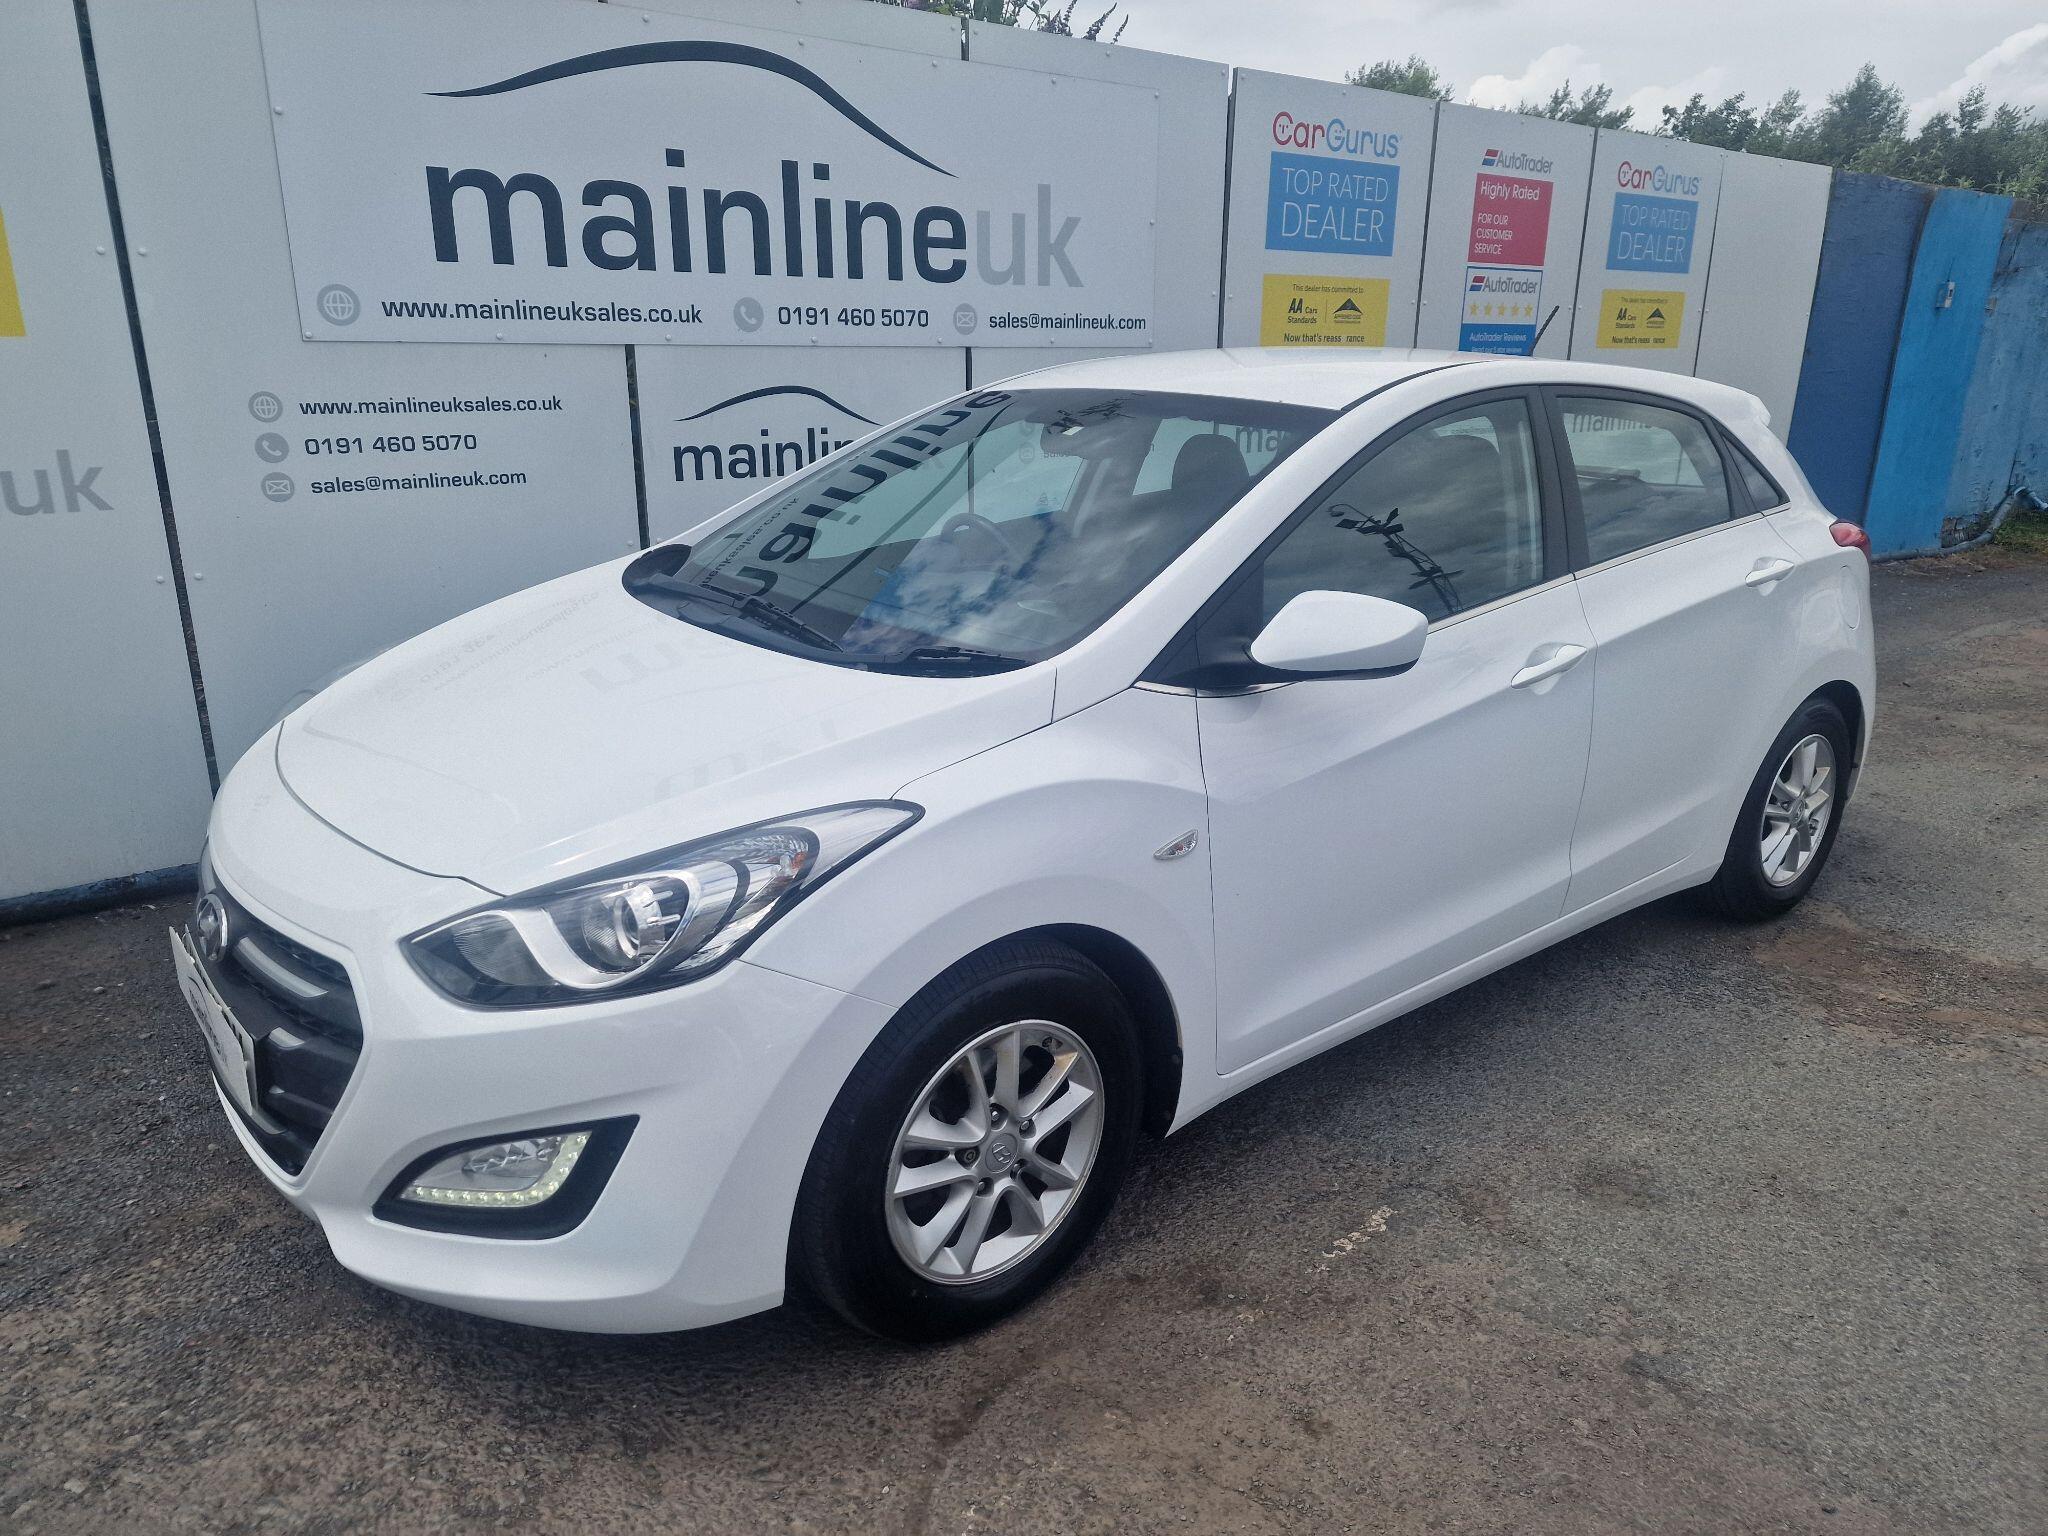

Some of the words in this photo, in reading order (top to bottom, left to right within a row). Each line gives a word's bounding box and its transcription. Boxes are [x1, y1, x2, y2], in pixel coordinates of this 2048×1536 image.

[1273, 111, 1399, 158] CarGurus
[1496, 151, 1553, 174] AutoTrader
[1283, 167, 1322, 195] TOP
[1328, 172, 1389, 202] RATED
[1618, 161, 1699, 195] CarGurus
[1481, 181, 1510, 200] Highly
[1513, 184, 1540, 200] Rated
[1281, 202, 1384, 242] DEALER
[1478, 212, 1492, 224] FOR
[1493, 214, 1508, 225] OUR
[1622, 204, 1648, 226] TOP
[1651, 207, 1690, 231] RATED
[1476, 228, 1513, 240] CUSTOMER
[1474, 242, 1503, 255] SERVICE
[1617, 232, 1686, 262] DEALER
[1482, 276, 1538, 294] AutoTrader
[381, 299, 702, 323] www.mainlineuksales.co.uk
[778, 306, 830, 326] 0191
[837, 308, 875, 327] 460
[881, 308, 929, 327] 5070
[989, 311, 1146, 330] sales@mainlineuk.com
[1288, 298, 1304, 313] AA
[1305, 306, 1318, 314] Cars
[1287, 316, 1317, 324] Standards
[1284, 333, 1300, 343] Now
[1302, 333, 1322, 343] that's
[299, 395, 562, 415] www.mainlineuksales.co.uk
[304, 438, 363, 455] 0191
[372, 436, 416, 453] 460
[421, 434, 477, 451] 5070
[310, 470, 527, 494] sales@mainlineuk.com
